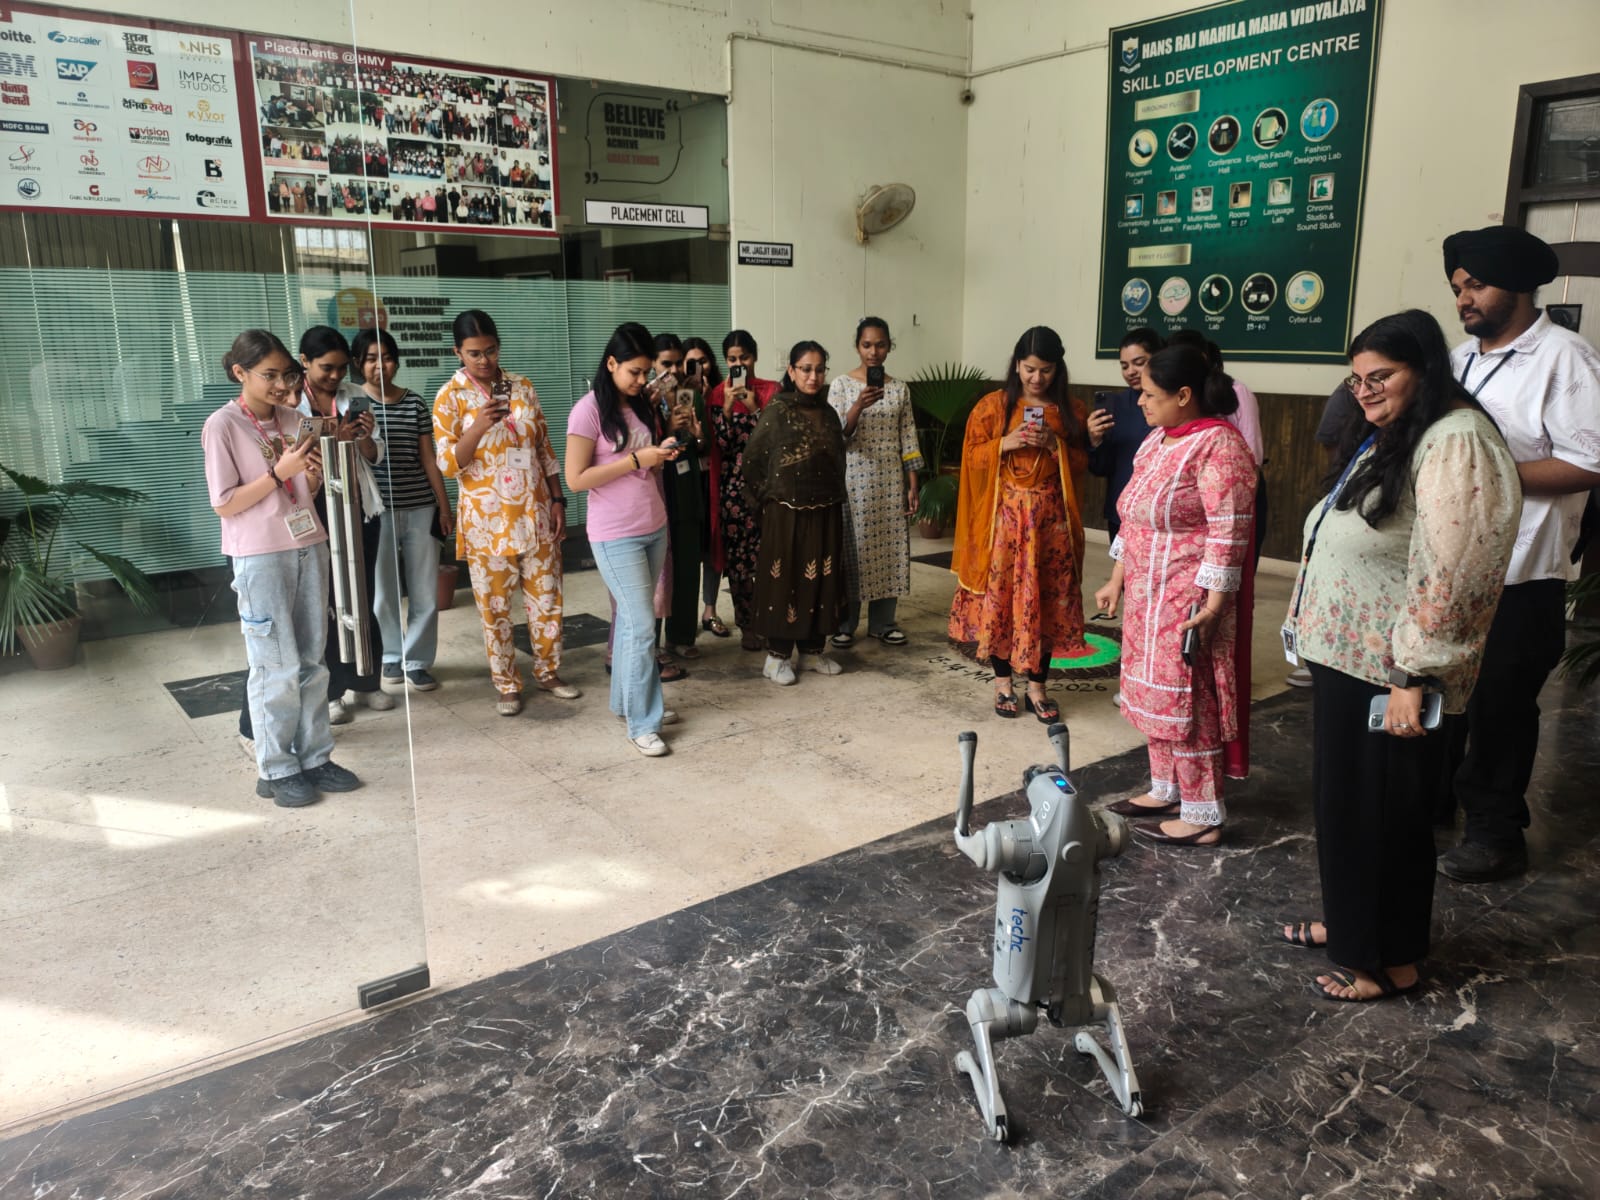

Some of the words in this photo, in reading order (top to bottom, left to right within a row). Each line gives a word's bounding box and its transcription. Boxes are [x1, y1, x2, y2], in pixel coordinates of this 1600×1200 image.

[1142, 36, 1172, 59] HANS
[1174, 32, 1197, 53] RAJ
[1198, 21, 1246, 48] MAHILA
[1248, 12, 1288, 36] MAHA
[1290, 0, 1366, 27] VIDYALAYA
[68, 35, 101, 46] zscaler
[190, 42, 221, 56] NHS
[264, 41, 338, 61] Placements
[1122, 73, 1161, 94] SKILL
[1165, 48, 1282, 87] DEVELOPMENT
[1287, 33, 1360, 62] CENTRE
[58, 61, 89, 78] SAP
[179, 70, 226, 84] IMPACT
[180, 81, 228, 93] STUDIOS
[604, 102, 665, 129] BELIEVE
[25, 124, 45, 132] BANK
[140, 127, 169, 136] vision
[1304, 144, 1331, 154] Fashion
[1246, 153, 1269, 163] English
[1270, 150, 1293, 160] Faculty
[1294, 154, 1326, 165] Designing
[1328, 152, 1342, 160] Lab
[1208, 157, 1242, 167] Conference
[1259, 160, 1278, 169] Room
[1170, 164, 1192, 172] Aviation
[1263, 207, 1294, 217] Language
[1307, 204, 1333, 212] Chroma
[611, 206, 662, 222] PLACEMENT
[666, 210, 685, 223] CELL
[1306, 212, 1328, 221] Studio
[1183, 223, 1204, 231] Faculty
[1297, 223, 1317, 231] Sound
[1319, 221, 1341, 230] Studio
[1289, 316, 1308, 324] Cyber
[390, 321, 419, 330] KEEPING
[405, 358, 438, 367] SUCCESS
[1048, 682, 1107, 692] 2026
